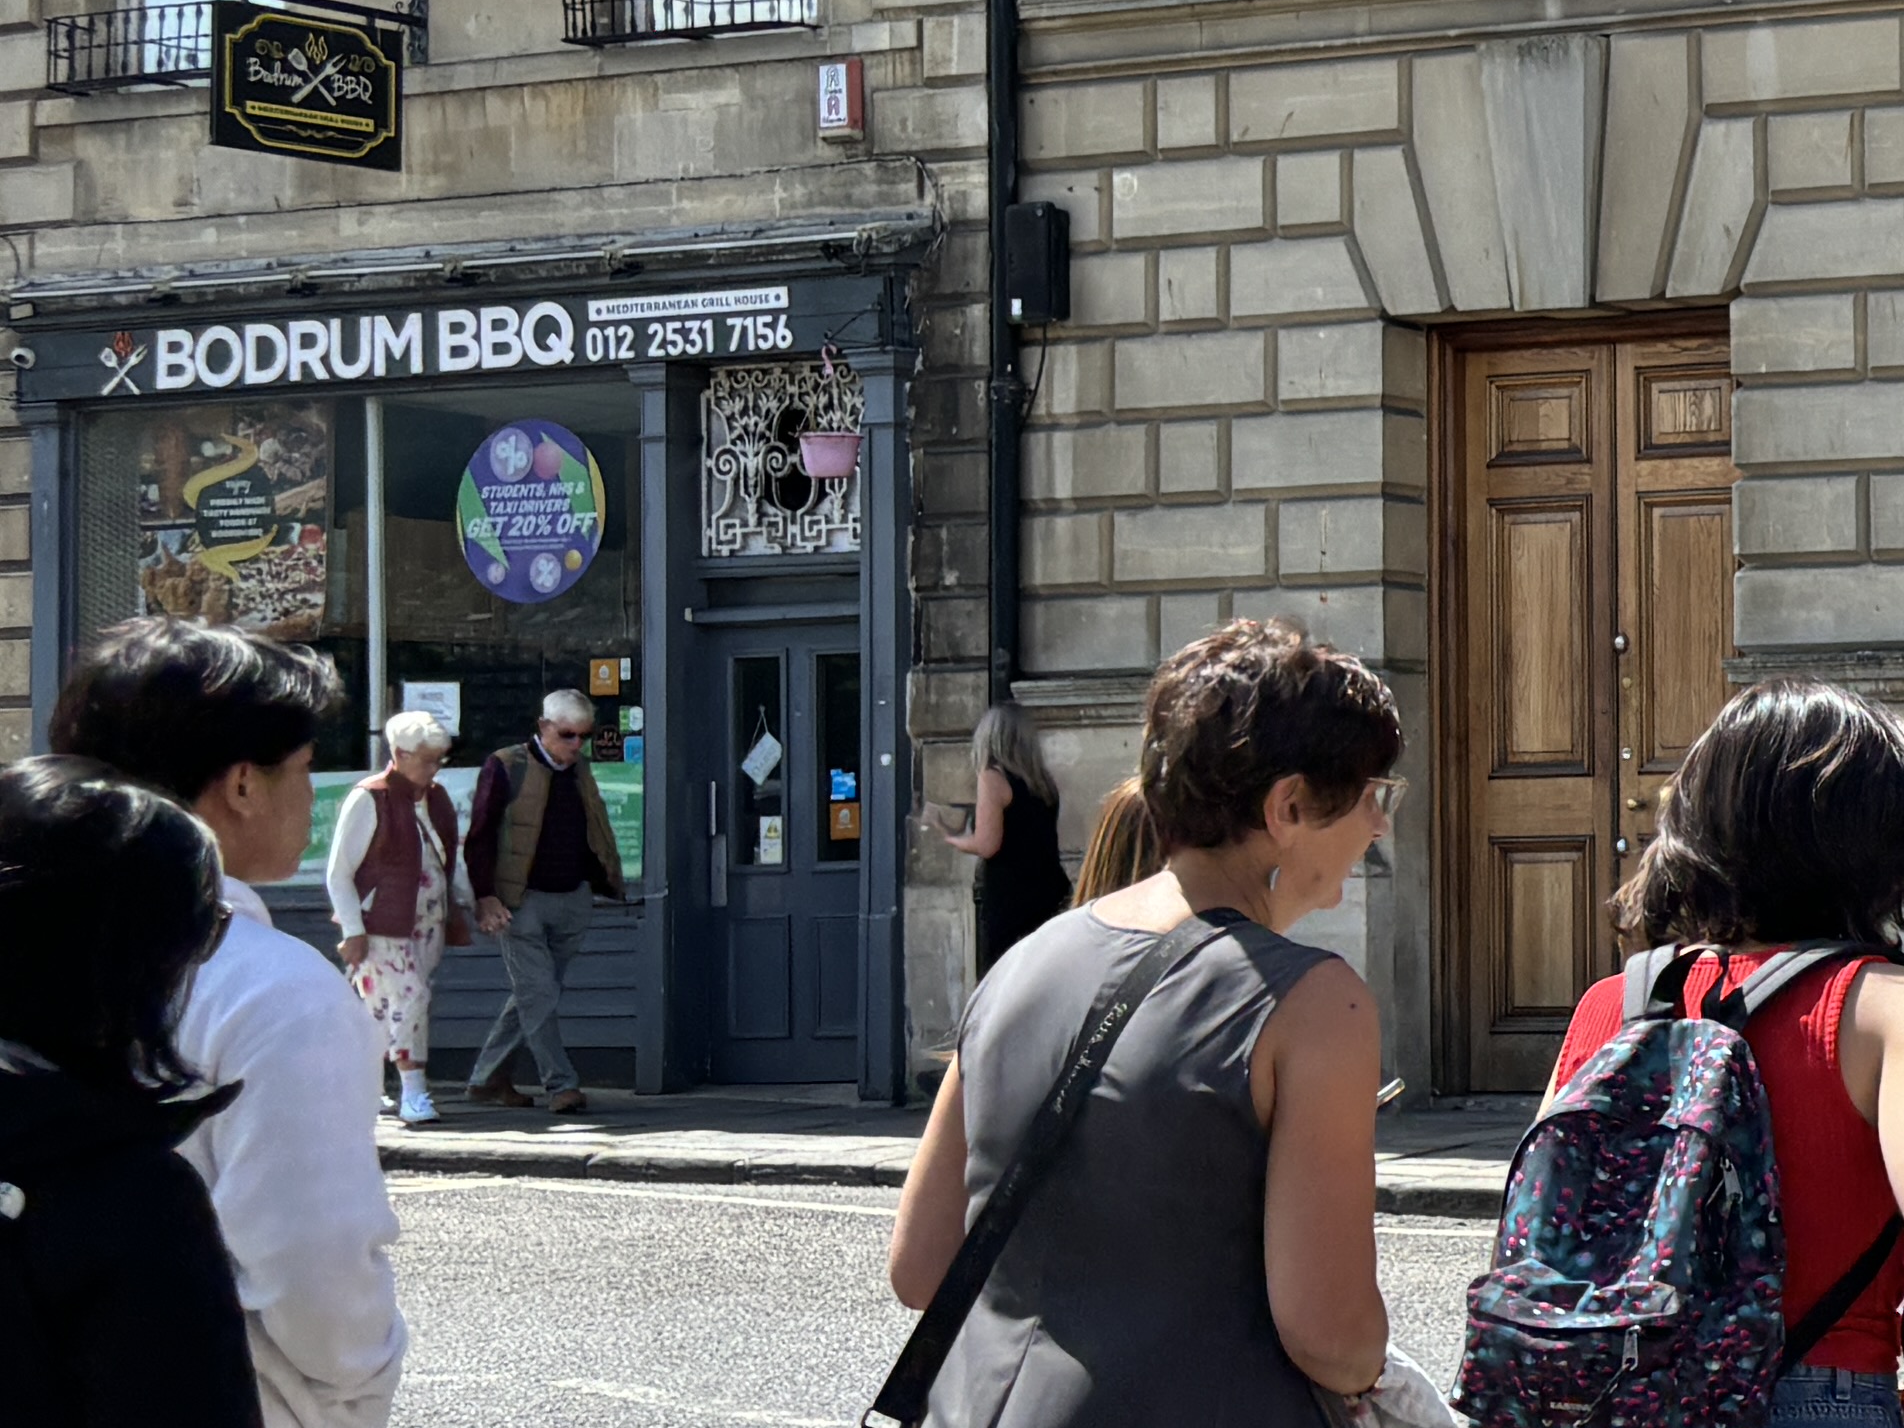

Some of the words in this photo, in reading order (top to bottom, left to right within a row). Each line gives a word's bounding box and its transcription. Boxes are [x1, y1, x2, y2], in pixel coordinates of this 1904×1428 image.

[331, 73, 374, 106] BBQ
[606, 297, 699, 315] MEDITERRANEAN
[701, 294, 731, 309] GRILL
[734, 293, 771, 306] HOUSE
[155, 312, 423, 390] BODRUM
[438, 301, 575, 372] BBQ
[585, 324, 636, 362] 012
[647, 319, 714, 358] 2531
[726, 314, 794, 352] 7156
[466, 516, 508, 539] GET
[507, 514, 553, 537] 20%
[556, 511, 599, 535] OFF
